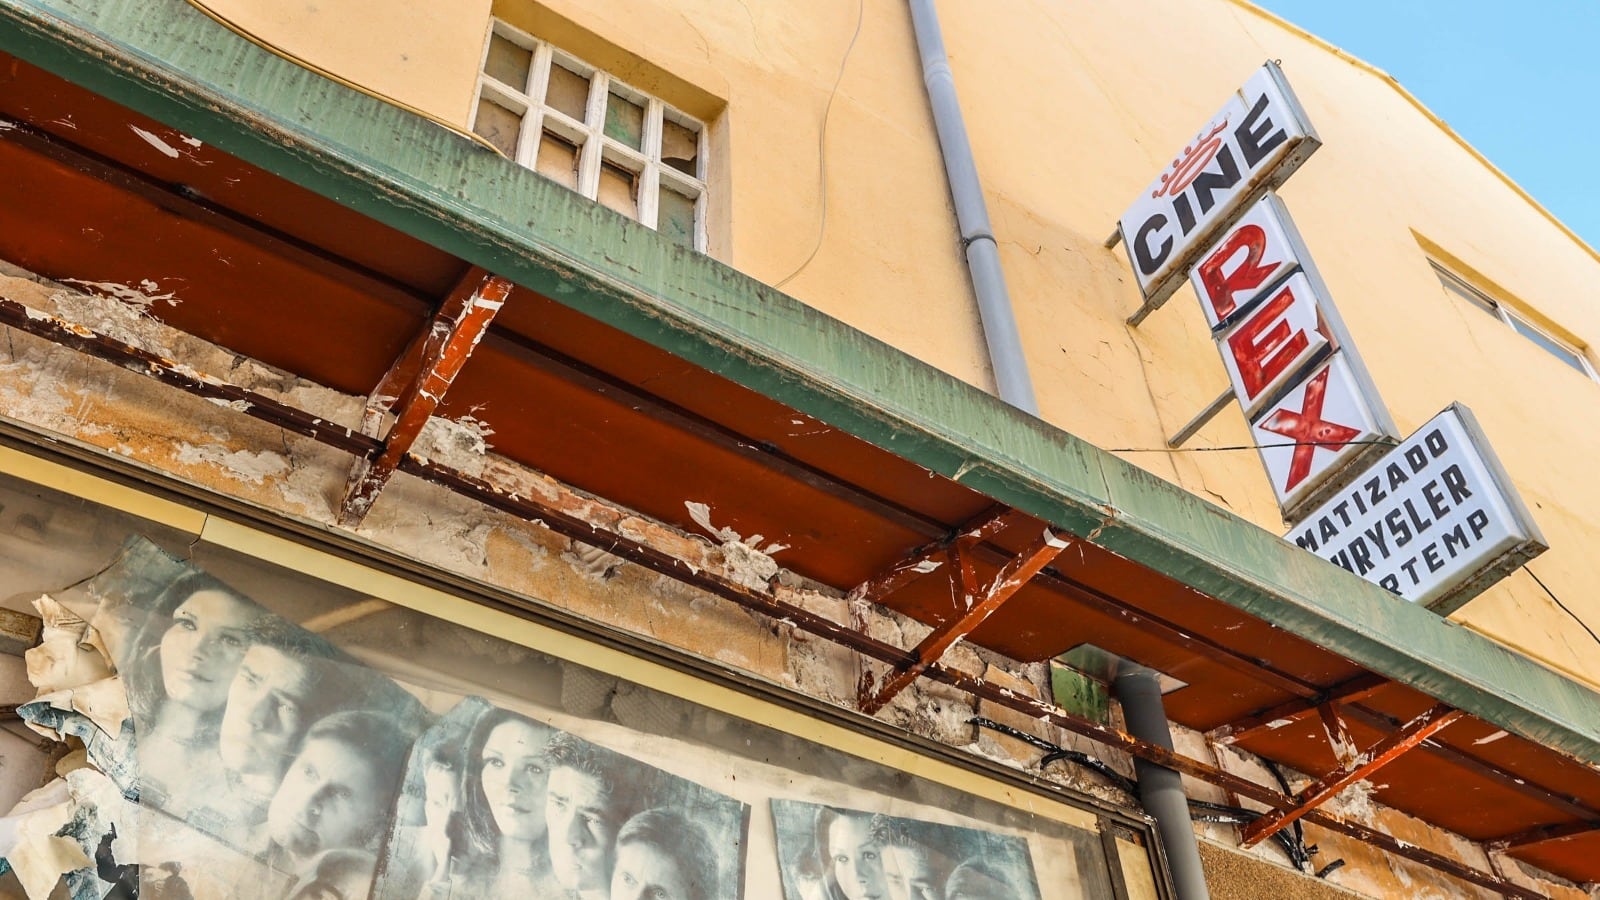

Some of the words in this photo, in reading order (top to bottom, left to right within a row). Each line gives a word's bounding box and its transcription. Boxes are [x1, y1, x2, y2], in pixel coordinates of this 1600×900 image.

[1134, 93, 1288, 275] CINE
[1198, 224, 1361, 493] REX
[1296, 428, 1449, 552] MATIZADO
